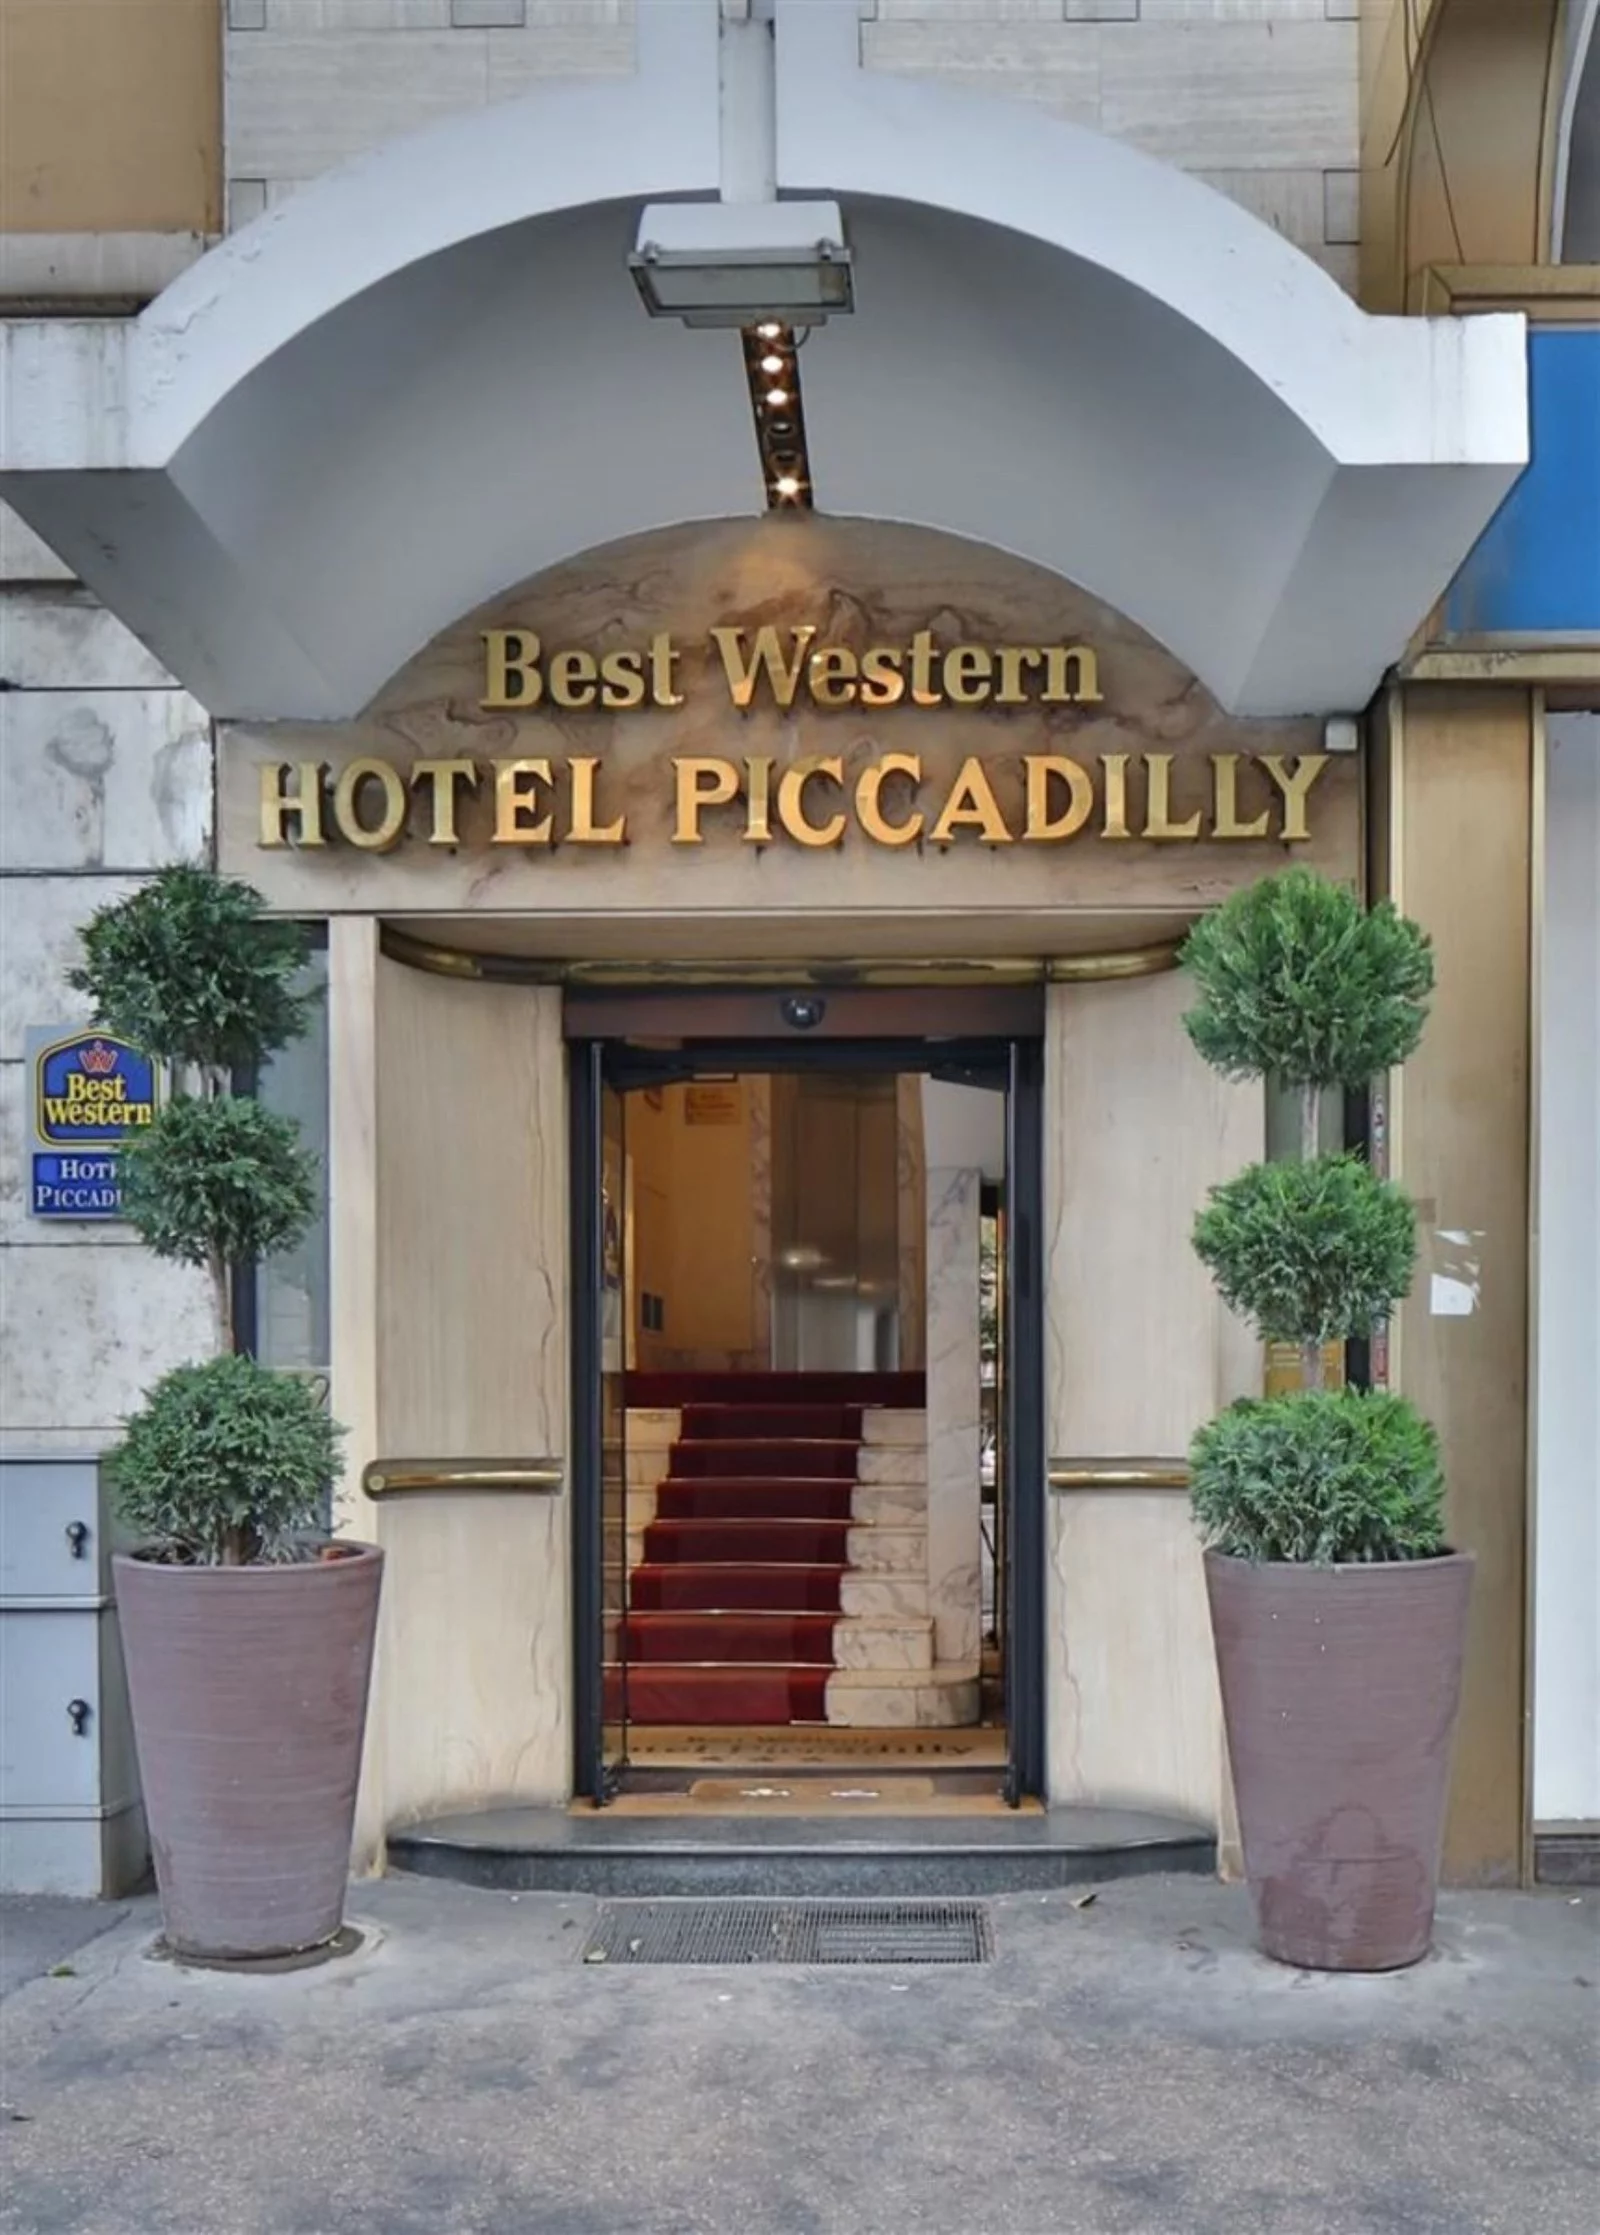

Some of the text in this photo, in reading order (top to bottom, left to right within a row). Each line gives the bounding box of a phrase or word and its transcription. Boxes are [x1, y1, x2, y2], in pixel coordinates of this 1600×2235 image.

[480, 624, 1104, 710] Best Western
[257, 753, 1328, 850] HOTEL PICCADILLY
[45, 1098, 152, 1125] Western
[67, 1074, 127, 1102] Best
